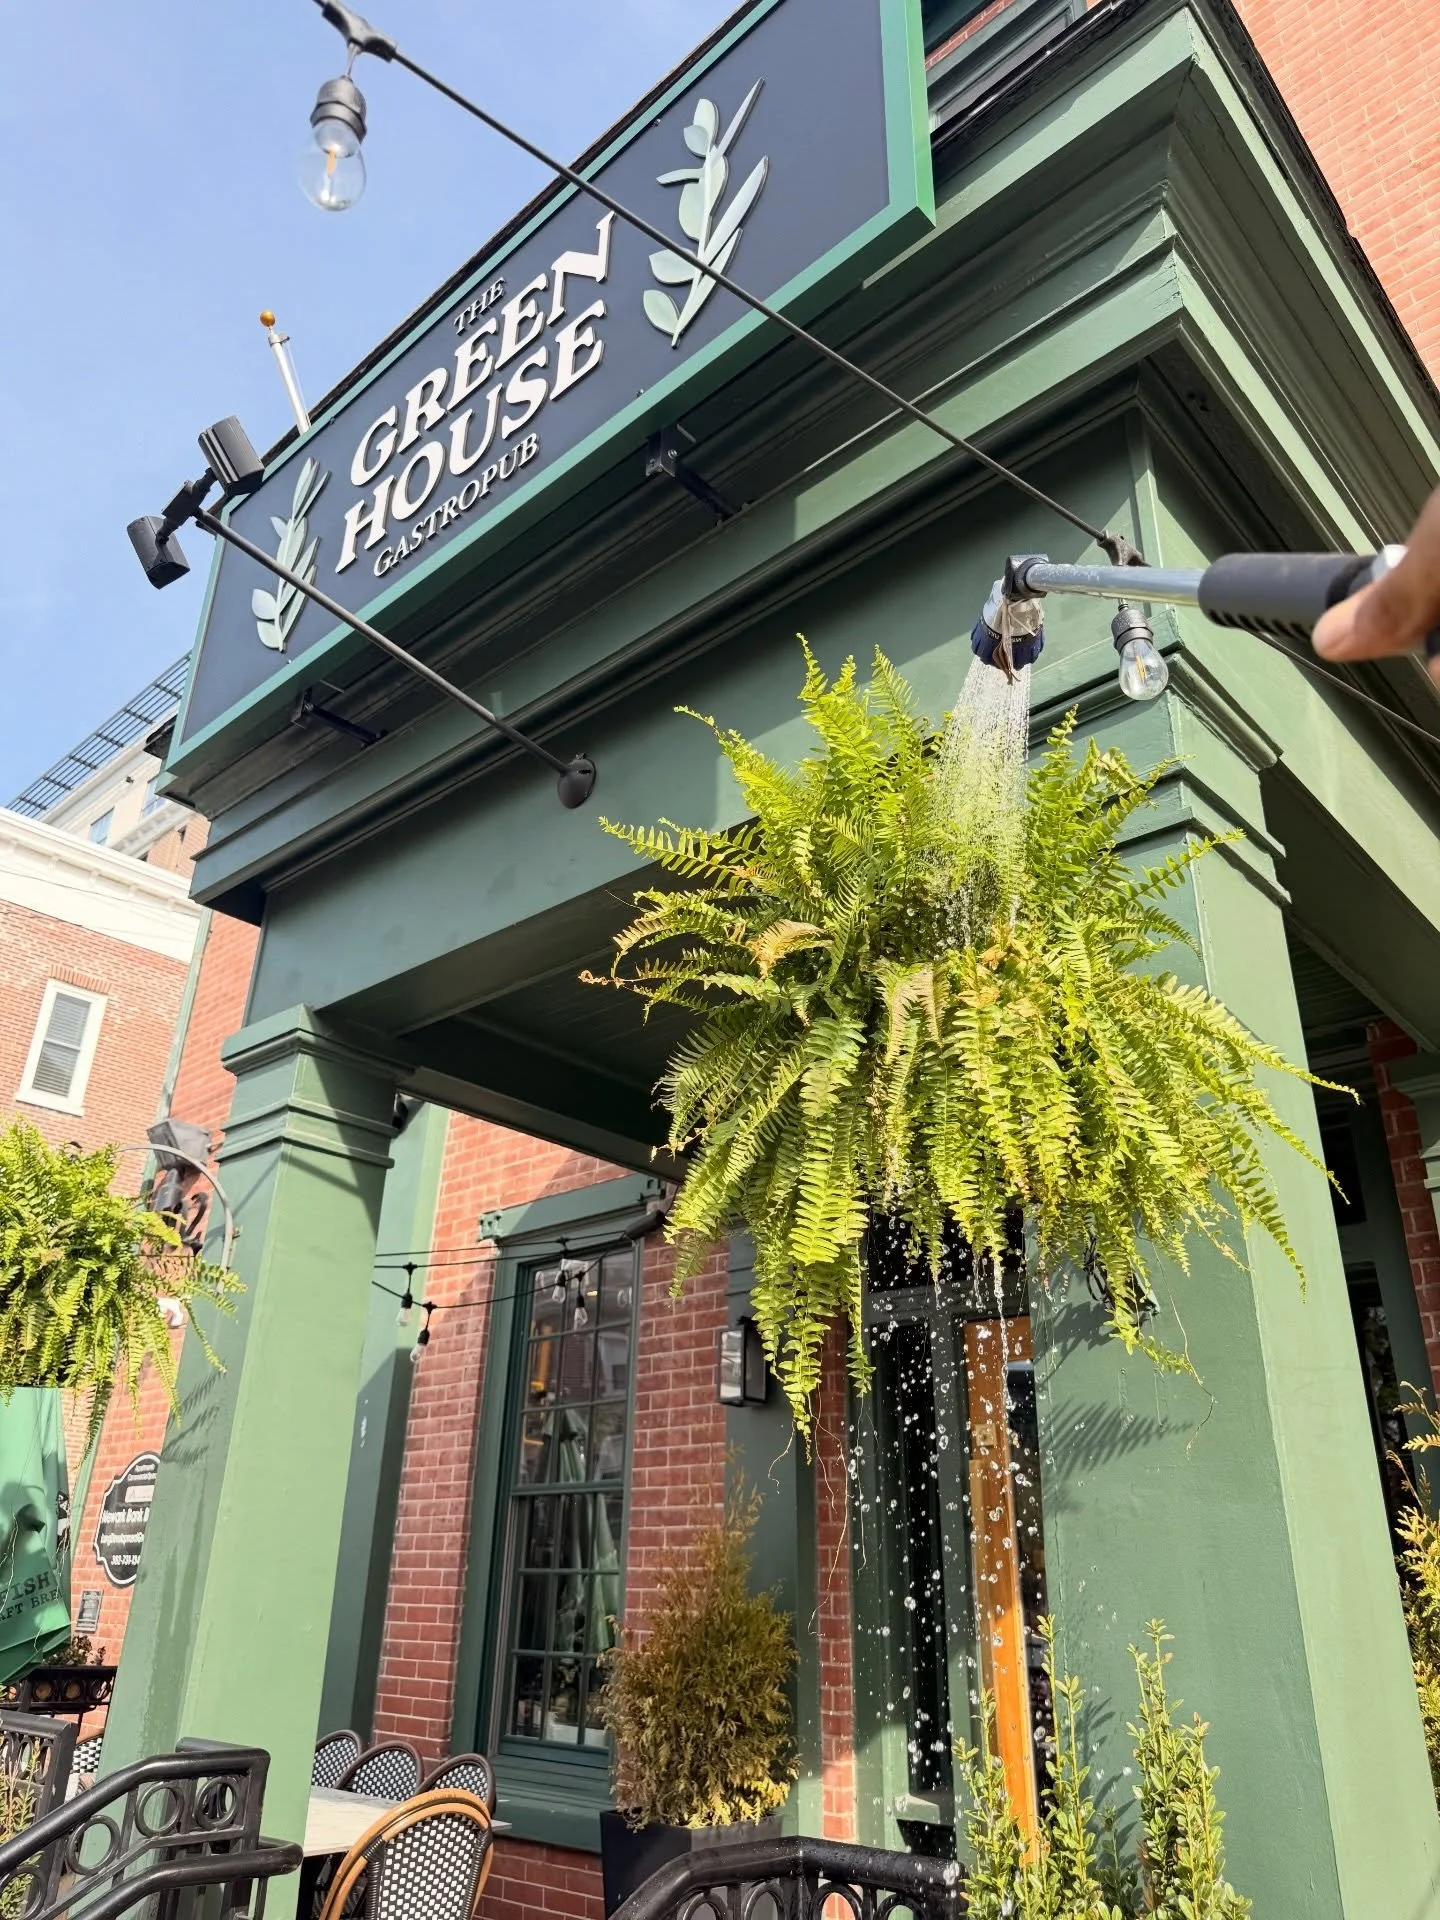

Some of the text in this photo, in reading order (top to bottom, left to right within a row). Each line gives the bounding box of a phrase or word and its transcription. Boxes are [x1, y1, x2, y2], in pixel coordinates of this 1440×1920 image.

[351, 210, 615, 486] GREEN
[454, 277, 506, 335] THE
[335, 300, 607, 573] HOUSE
[373, 432, 539, 577] GASTROPUB
